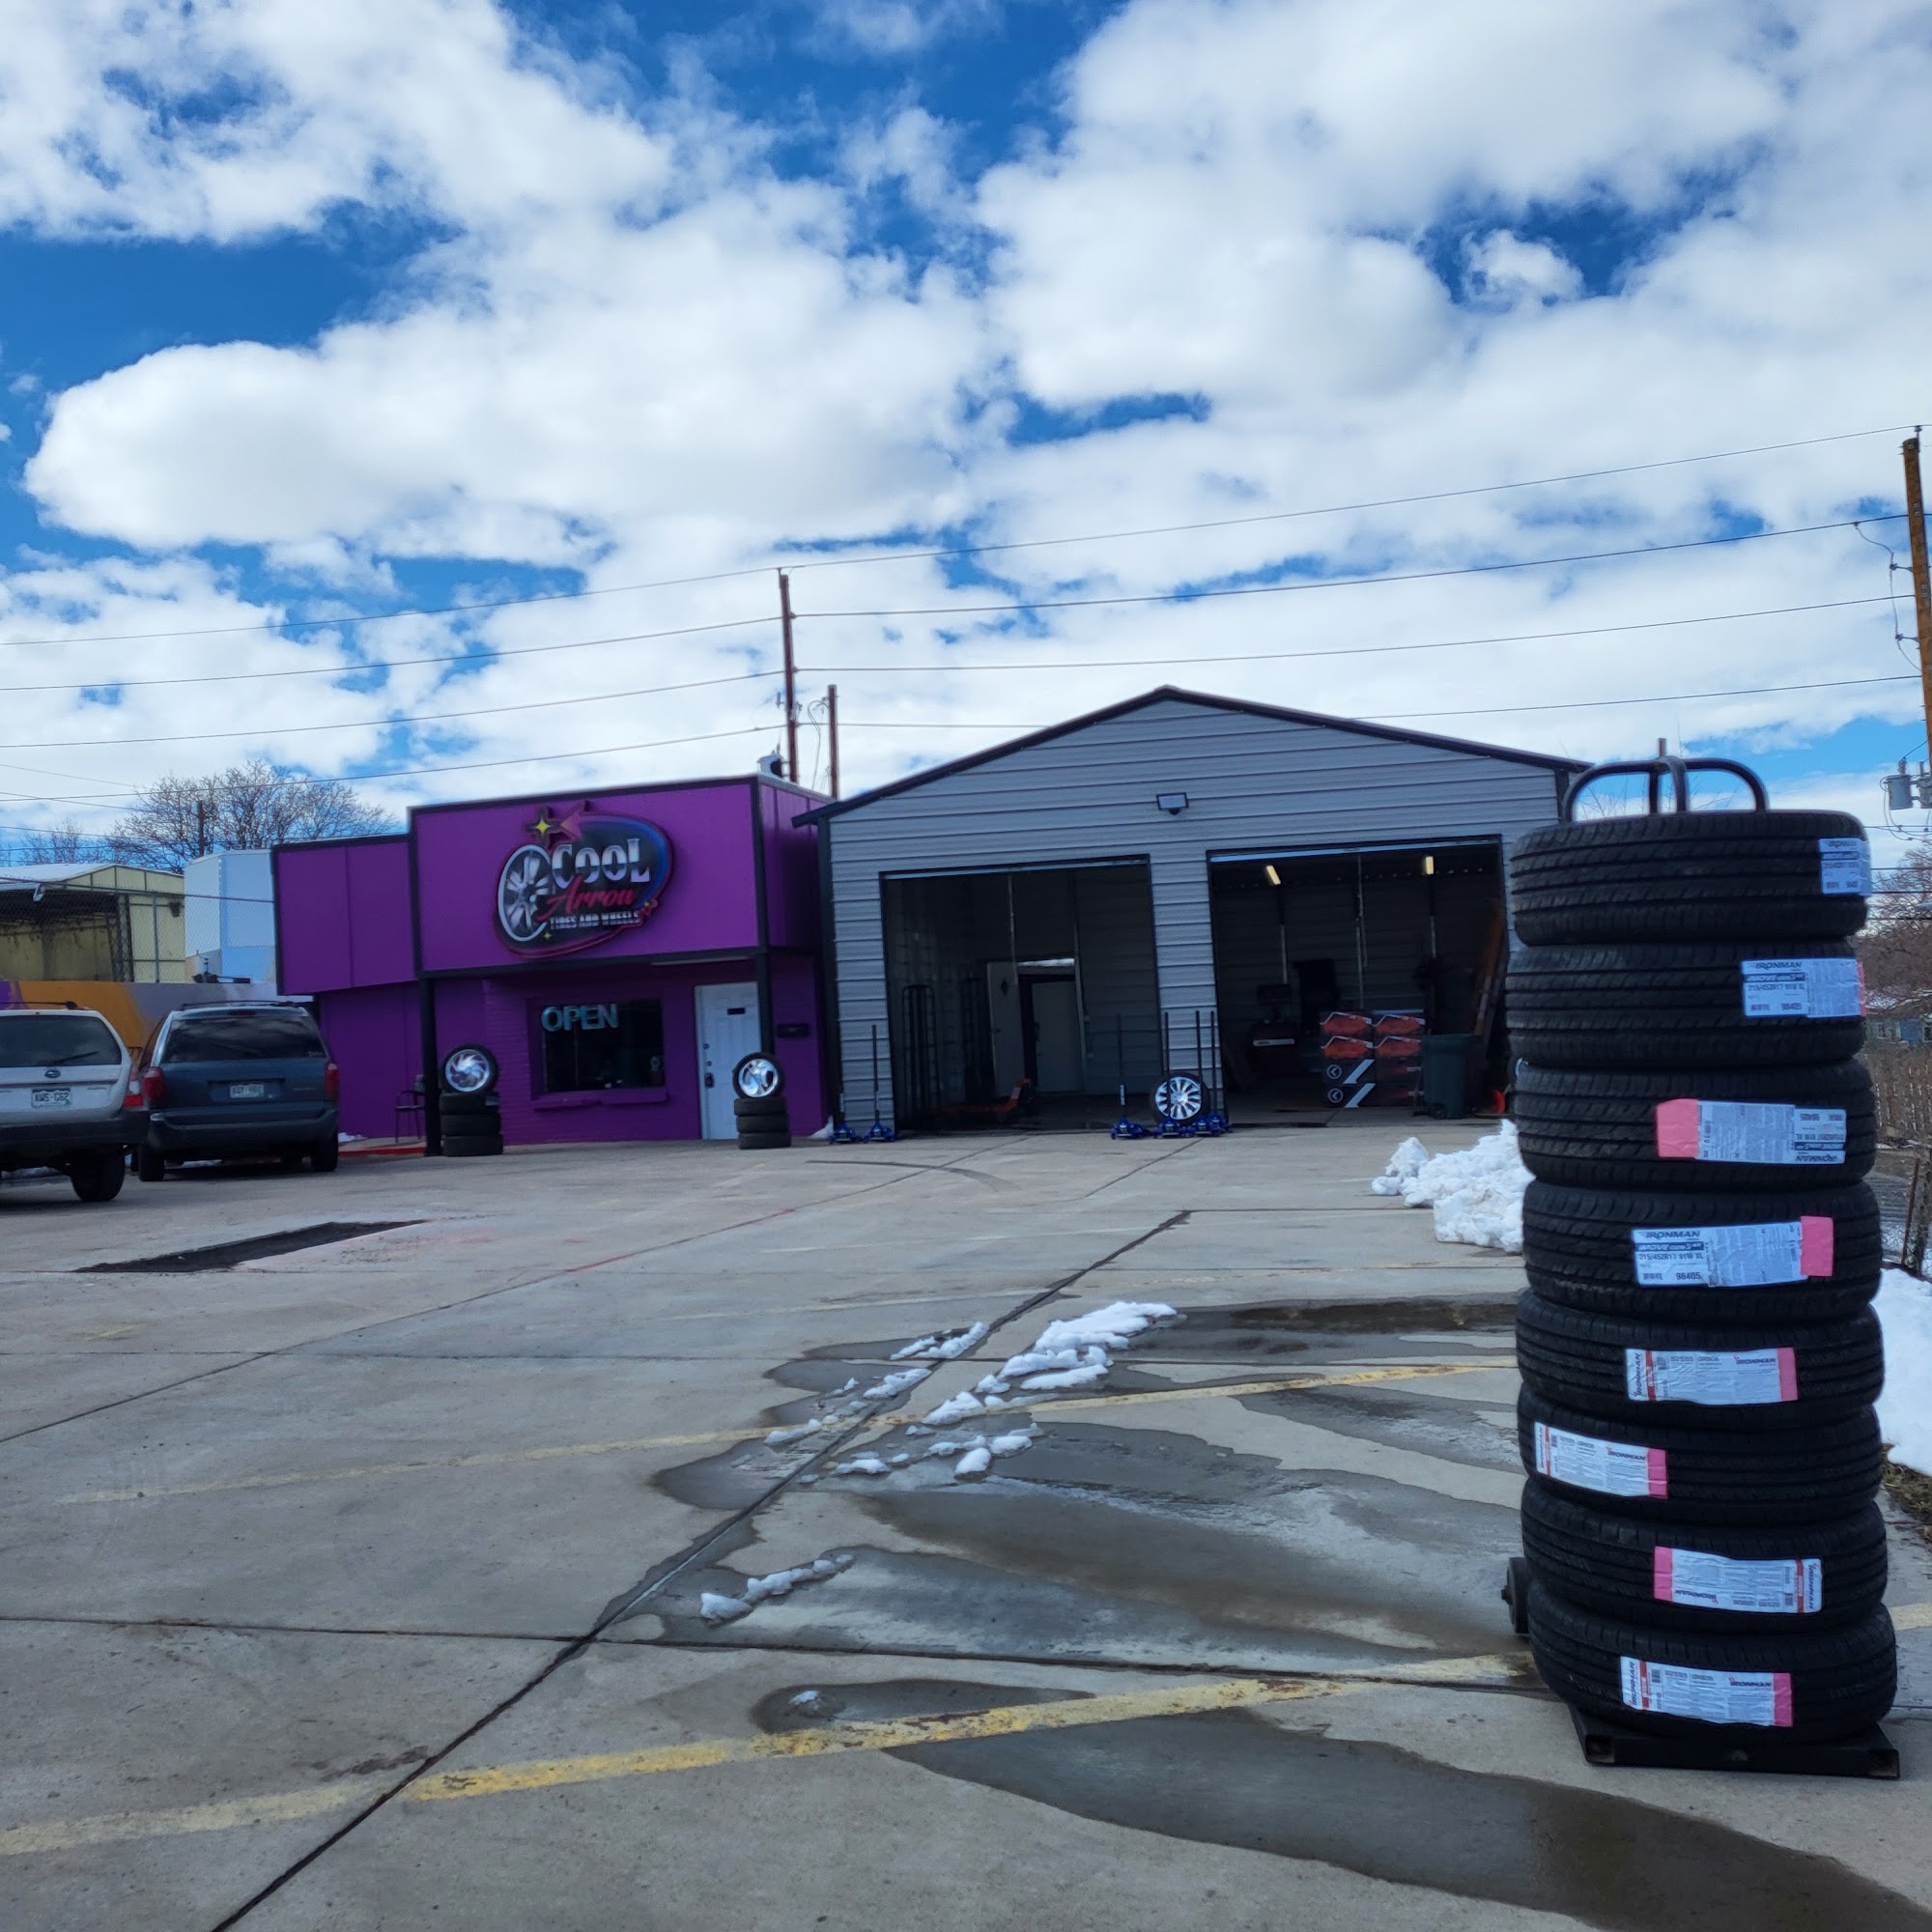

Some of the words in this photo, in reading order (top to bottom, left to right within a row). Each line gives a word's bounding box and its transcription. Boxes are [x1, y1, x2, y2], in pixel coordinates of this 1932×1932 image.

[552, 838, 650, 888] COOL
[537, 876, 636, 921] Arrow
[580, 914, 599, 926] AND
[601, 910, 640, 925] WHEELS
[1755, 961, 1803, 970] IRONMAN
[541, 1004, 618, 1032] OPEN
[1645, 1231, 1700, 1239] IRONMAN
[1607, 1450, 1646, 1462] IRONMAN
